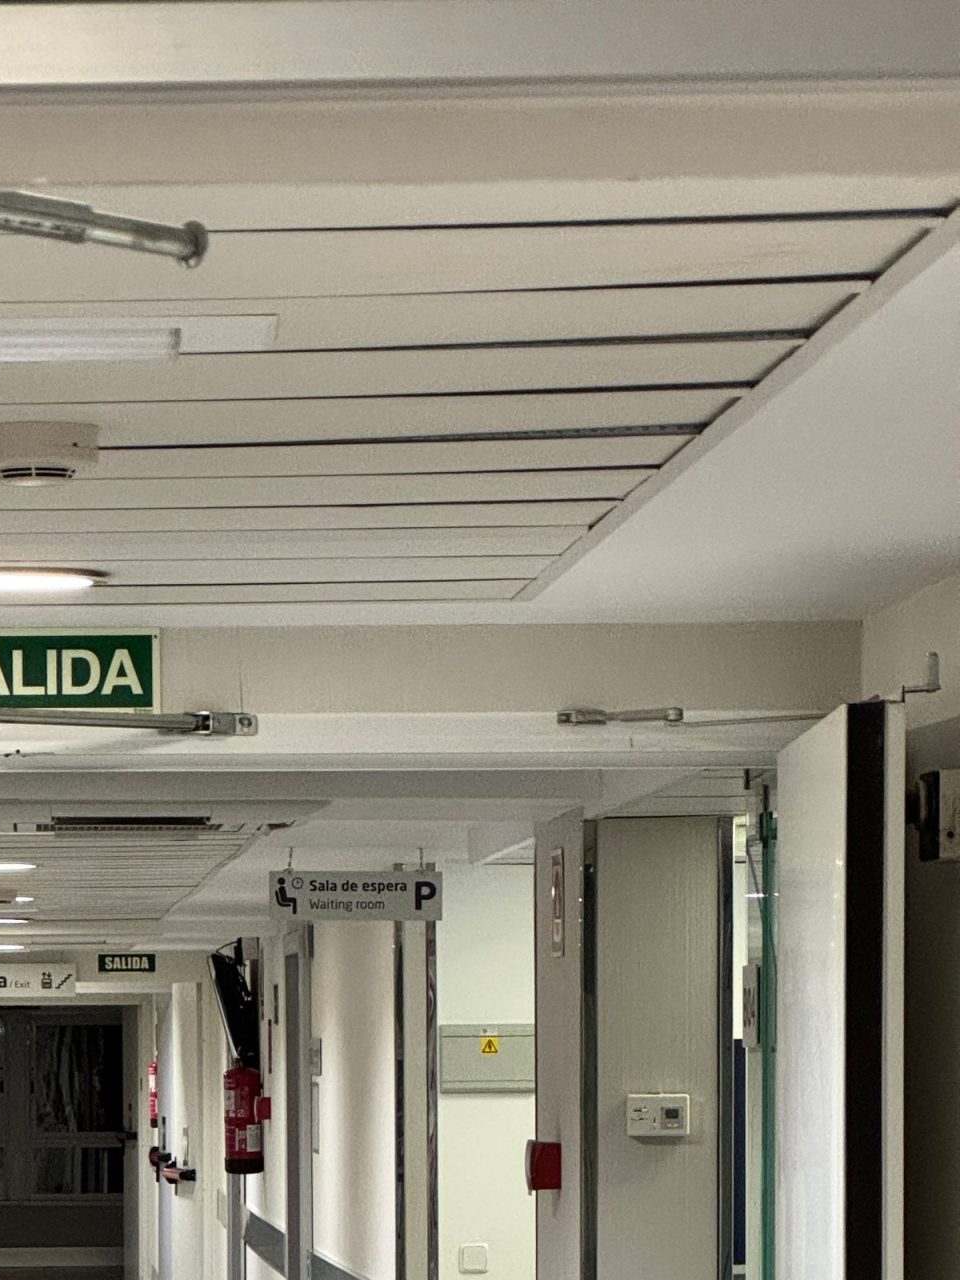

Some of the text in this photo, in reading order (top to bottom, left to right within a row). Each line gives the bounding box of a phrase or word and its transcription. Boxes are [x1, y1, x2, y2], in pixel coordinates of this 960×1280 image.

[309, 879, 407, 894] Sala de espera
[415, 880, 437, 911] P
[309, 899, 385, 911] Waiting room
[104, 956, 149, 970] SALIDA
[14, 979, 31, 988] Exit
